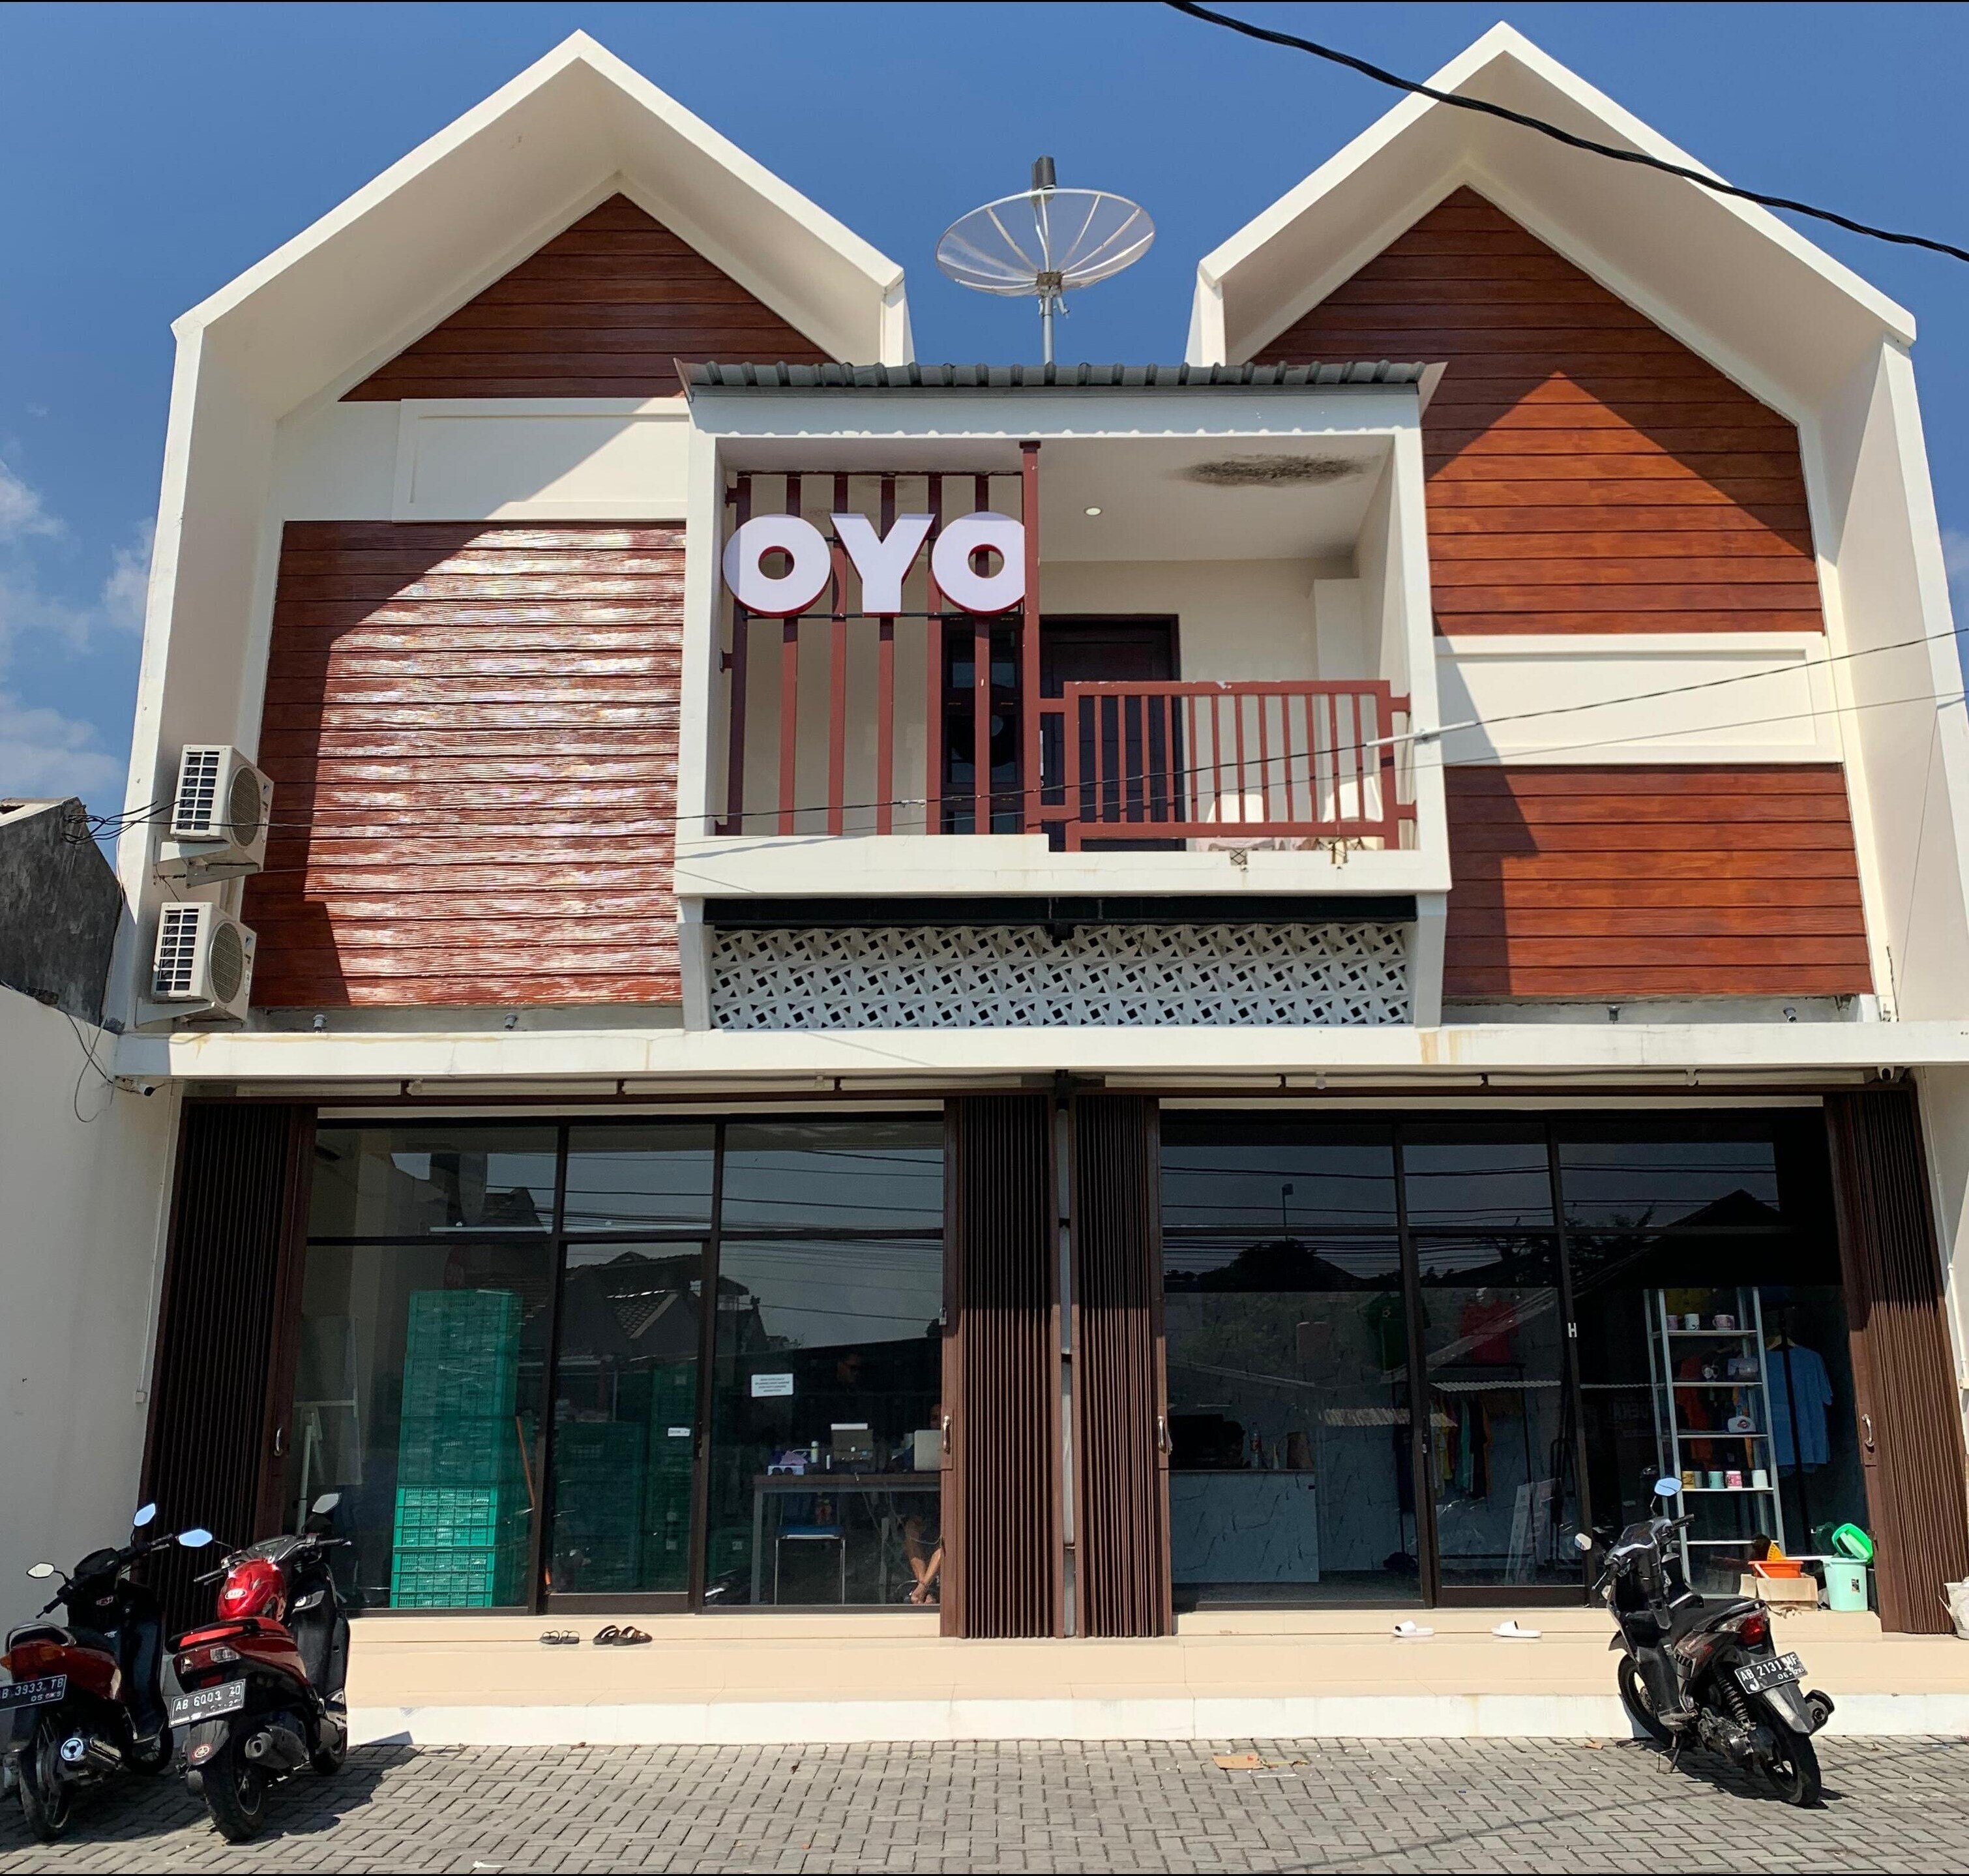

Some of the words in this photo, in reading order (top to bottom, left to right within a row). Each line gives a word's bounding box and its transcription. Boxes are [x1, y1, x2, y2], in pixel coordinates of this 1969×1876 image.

[722, 511, 1026, 617] OYO
[1740, 1669, 1754, 1681] AB
[1756, 1660, 1783, 1676] 2131
[0, 1688, 9, 1699] B
[14, 1682, 43, 1695] 3933
[51, 1677, 64, 1690] TB
[175, 1699, 188, 1711] AB
[194, 1691, 222, 1706] 6003
